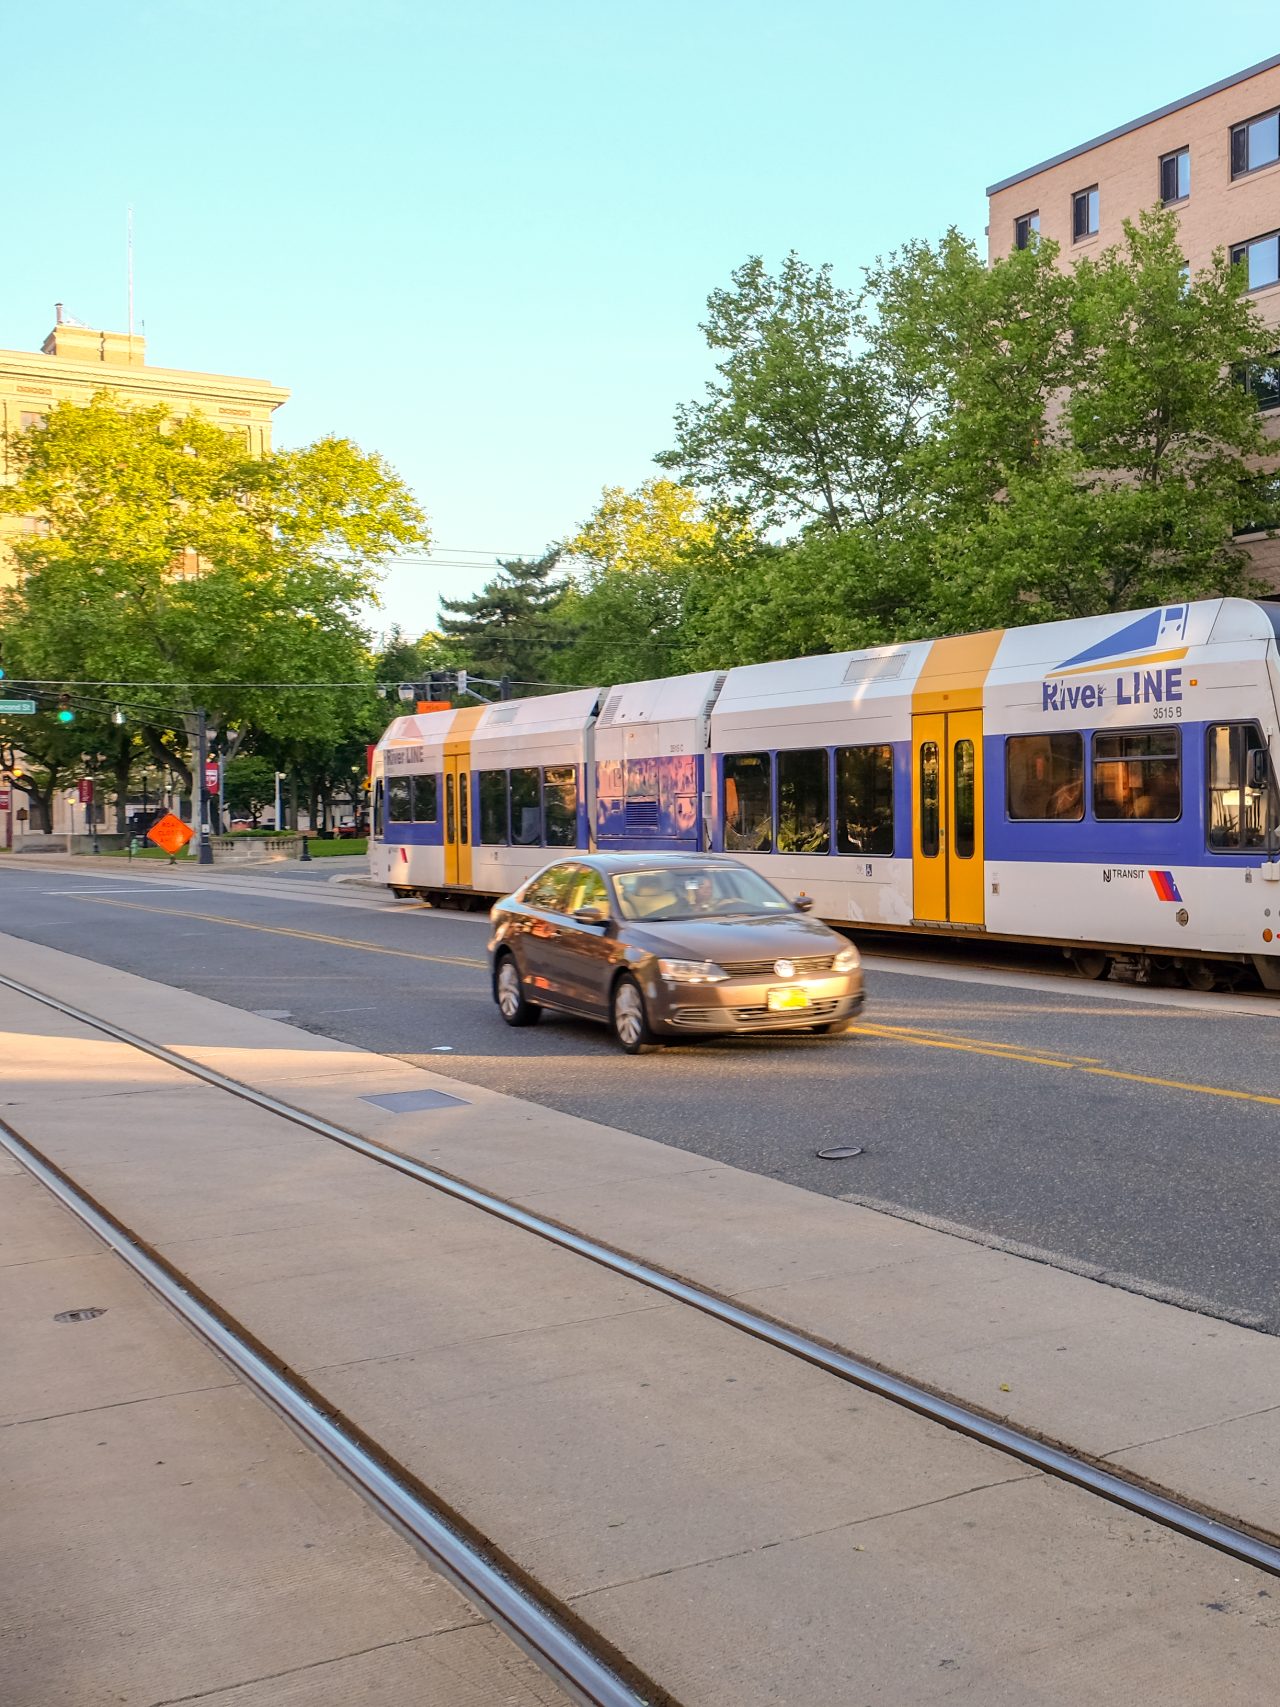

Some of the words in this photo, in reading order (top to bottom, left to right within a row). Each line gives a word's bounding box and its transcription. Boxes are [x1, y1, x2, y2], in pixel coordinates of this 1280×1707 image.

[1042, 680, 1106, 712] River
[1116, 668, 1183, 705] LINE
[0, 703, 21, 711] econd
[1153, 707, 1174, 719] 3515
[1175, 706, 1182, 718] B
[1112, 869, 1145, 879] TRANSIT
